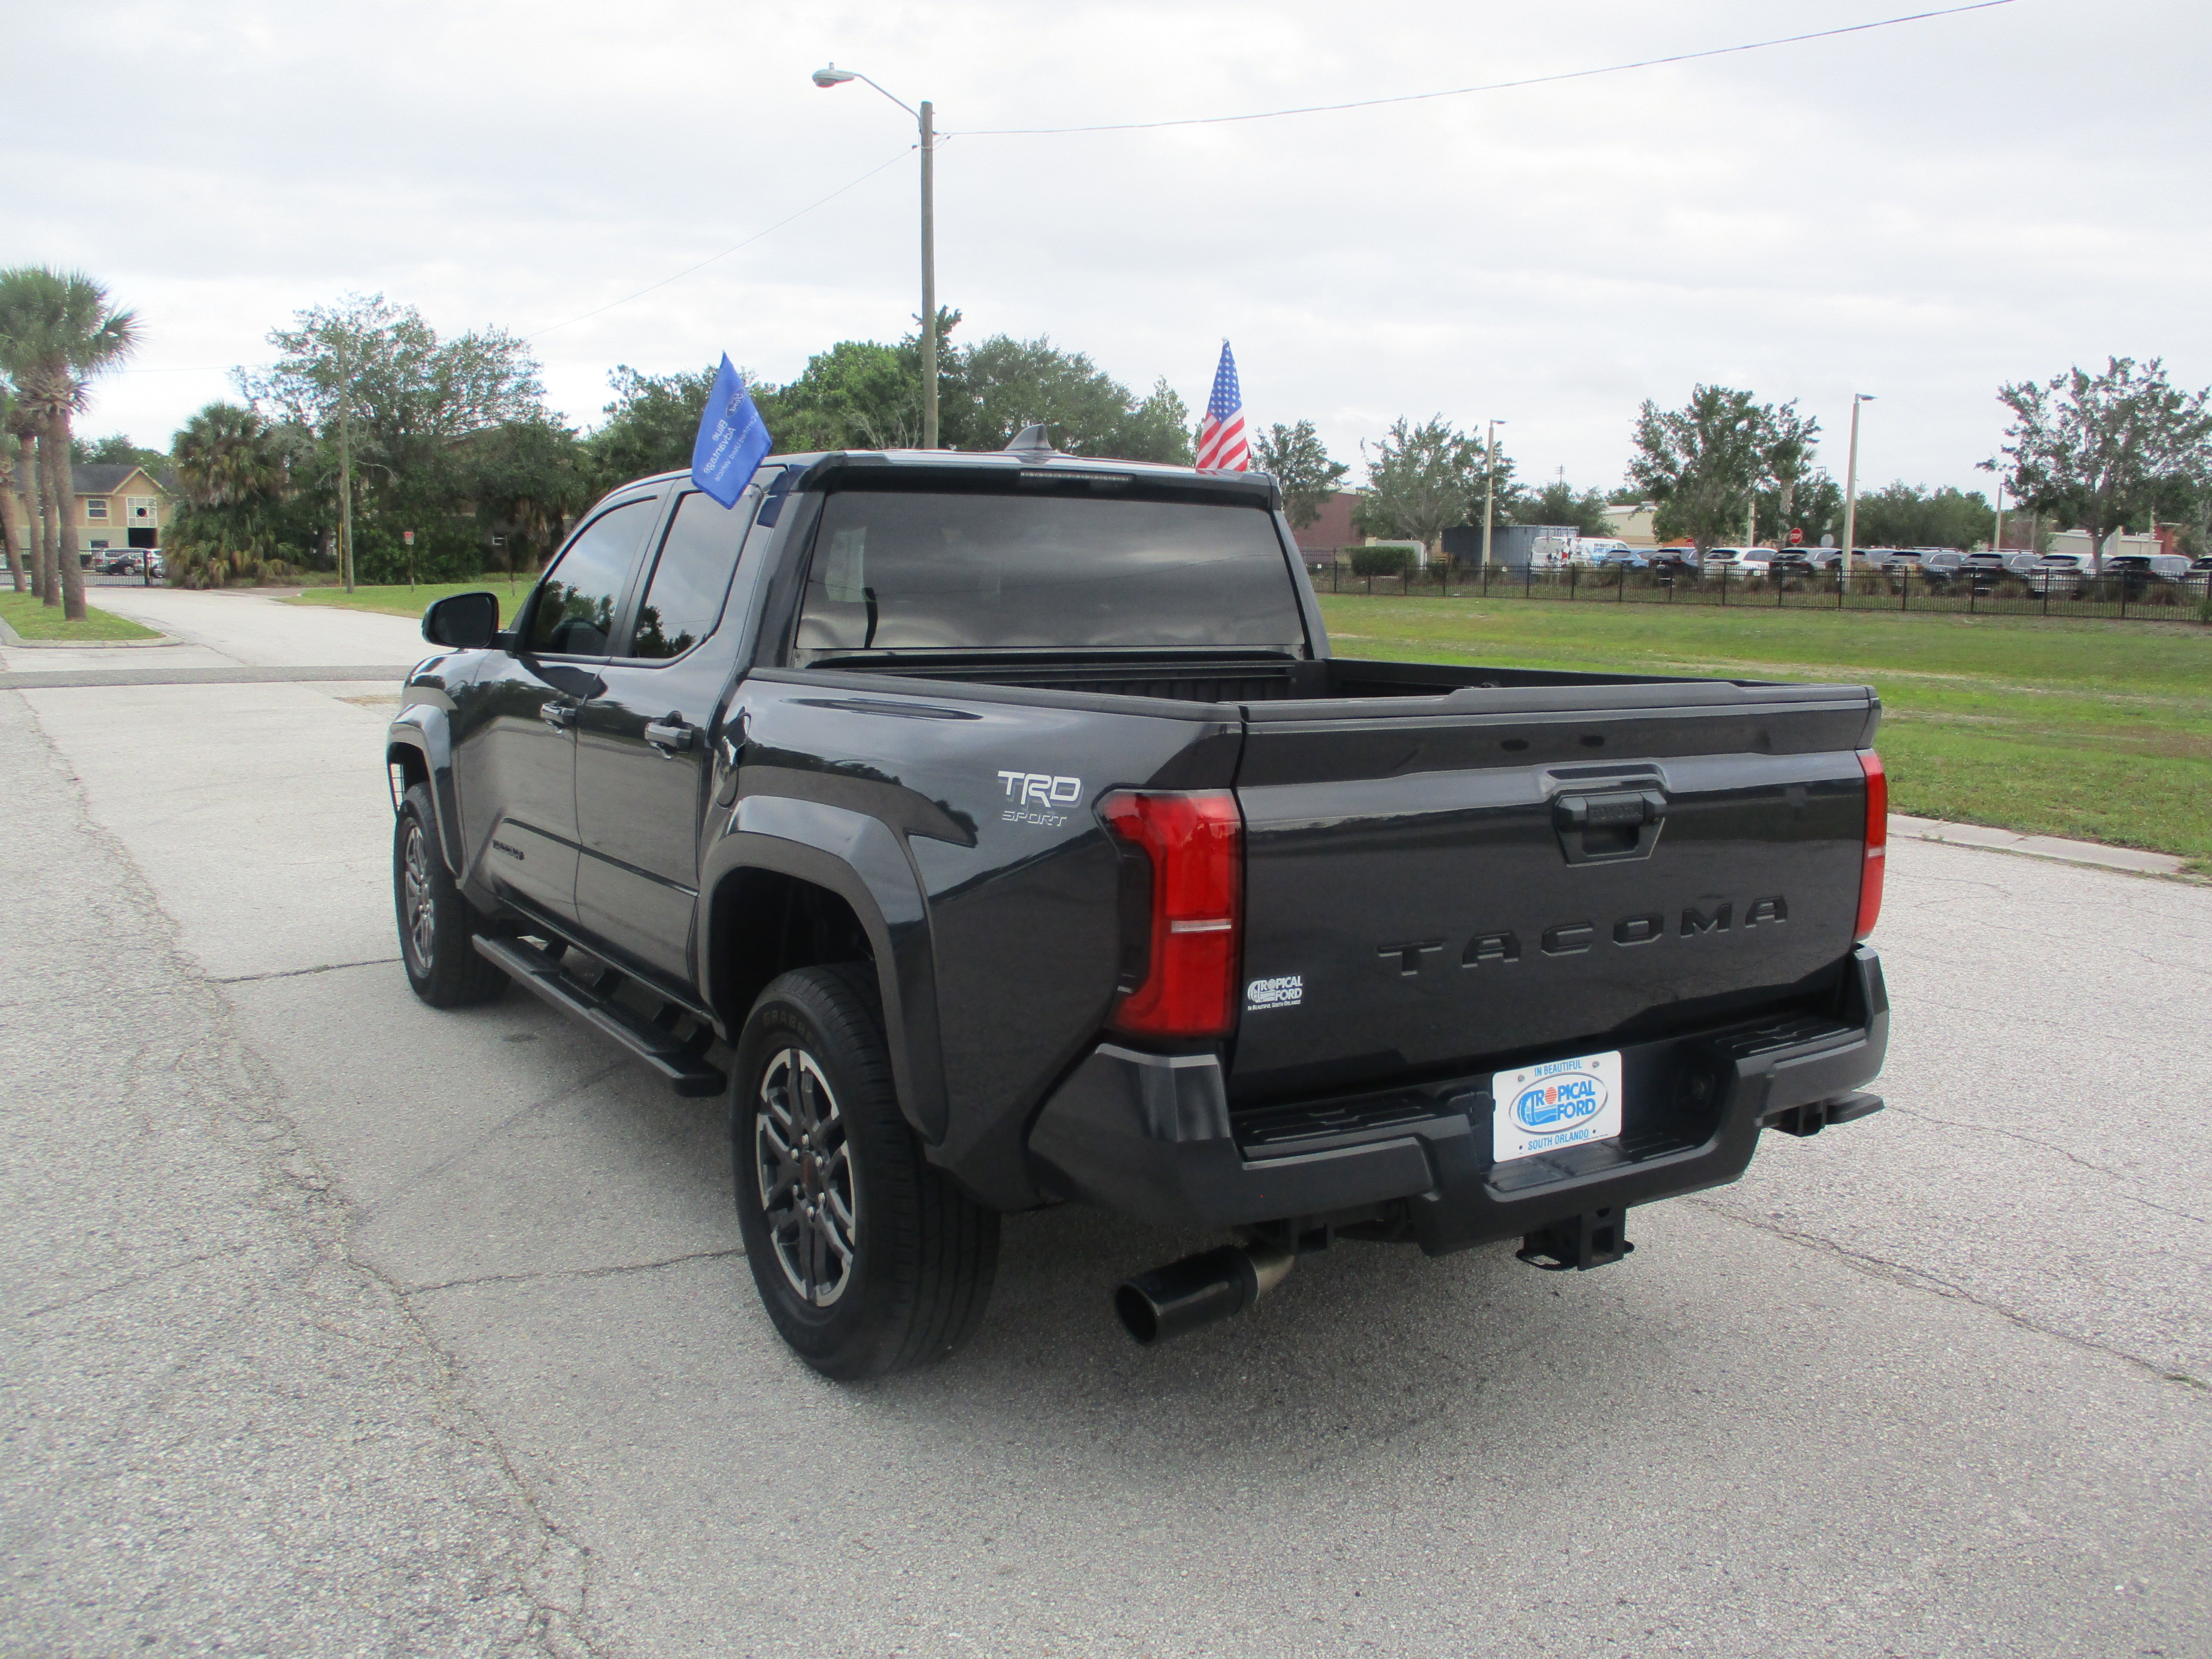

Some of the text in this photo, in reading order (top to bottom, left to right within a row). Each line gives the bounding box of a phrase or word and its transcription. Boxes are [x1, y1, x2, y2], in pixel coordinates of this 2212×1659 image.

[997, 771, 1081, 808] TRD
[1002, 811, 1067, 826] SPORT
[1378, 895, 1789, 976] TACOMA
[1248, 975, 1303, 998] TROPICAL
[1275, 988, 1302, 1001] FORD
[1534, 1060, 1582, 1076] IN BEAUTIFUL
[1517, 1080, 1596, 1116] TROPICAL
[1557, 1098, 1596, 1120] FORD
[1528, 1136, 1553, 1150] SOUTH
[1555, 1129, 1589, 1144] ORLANDO
